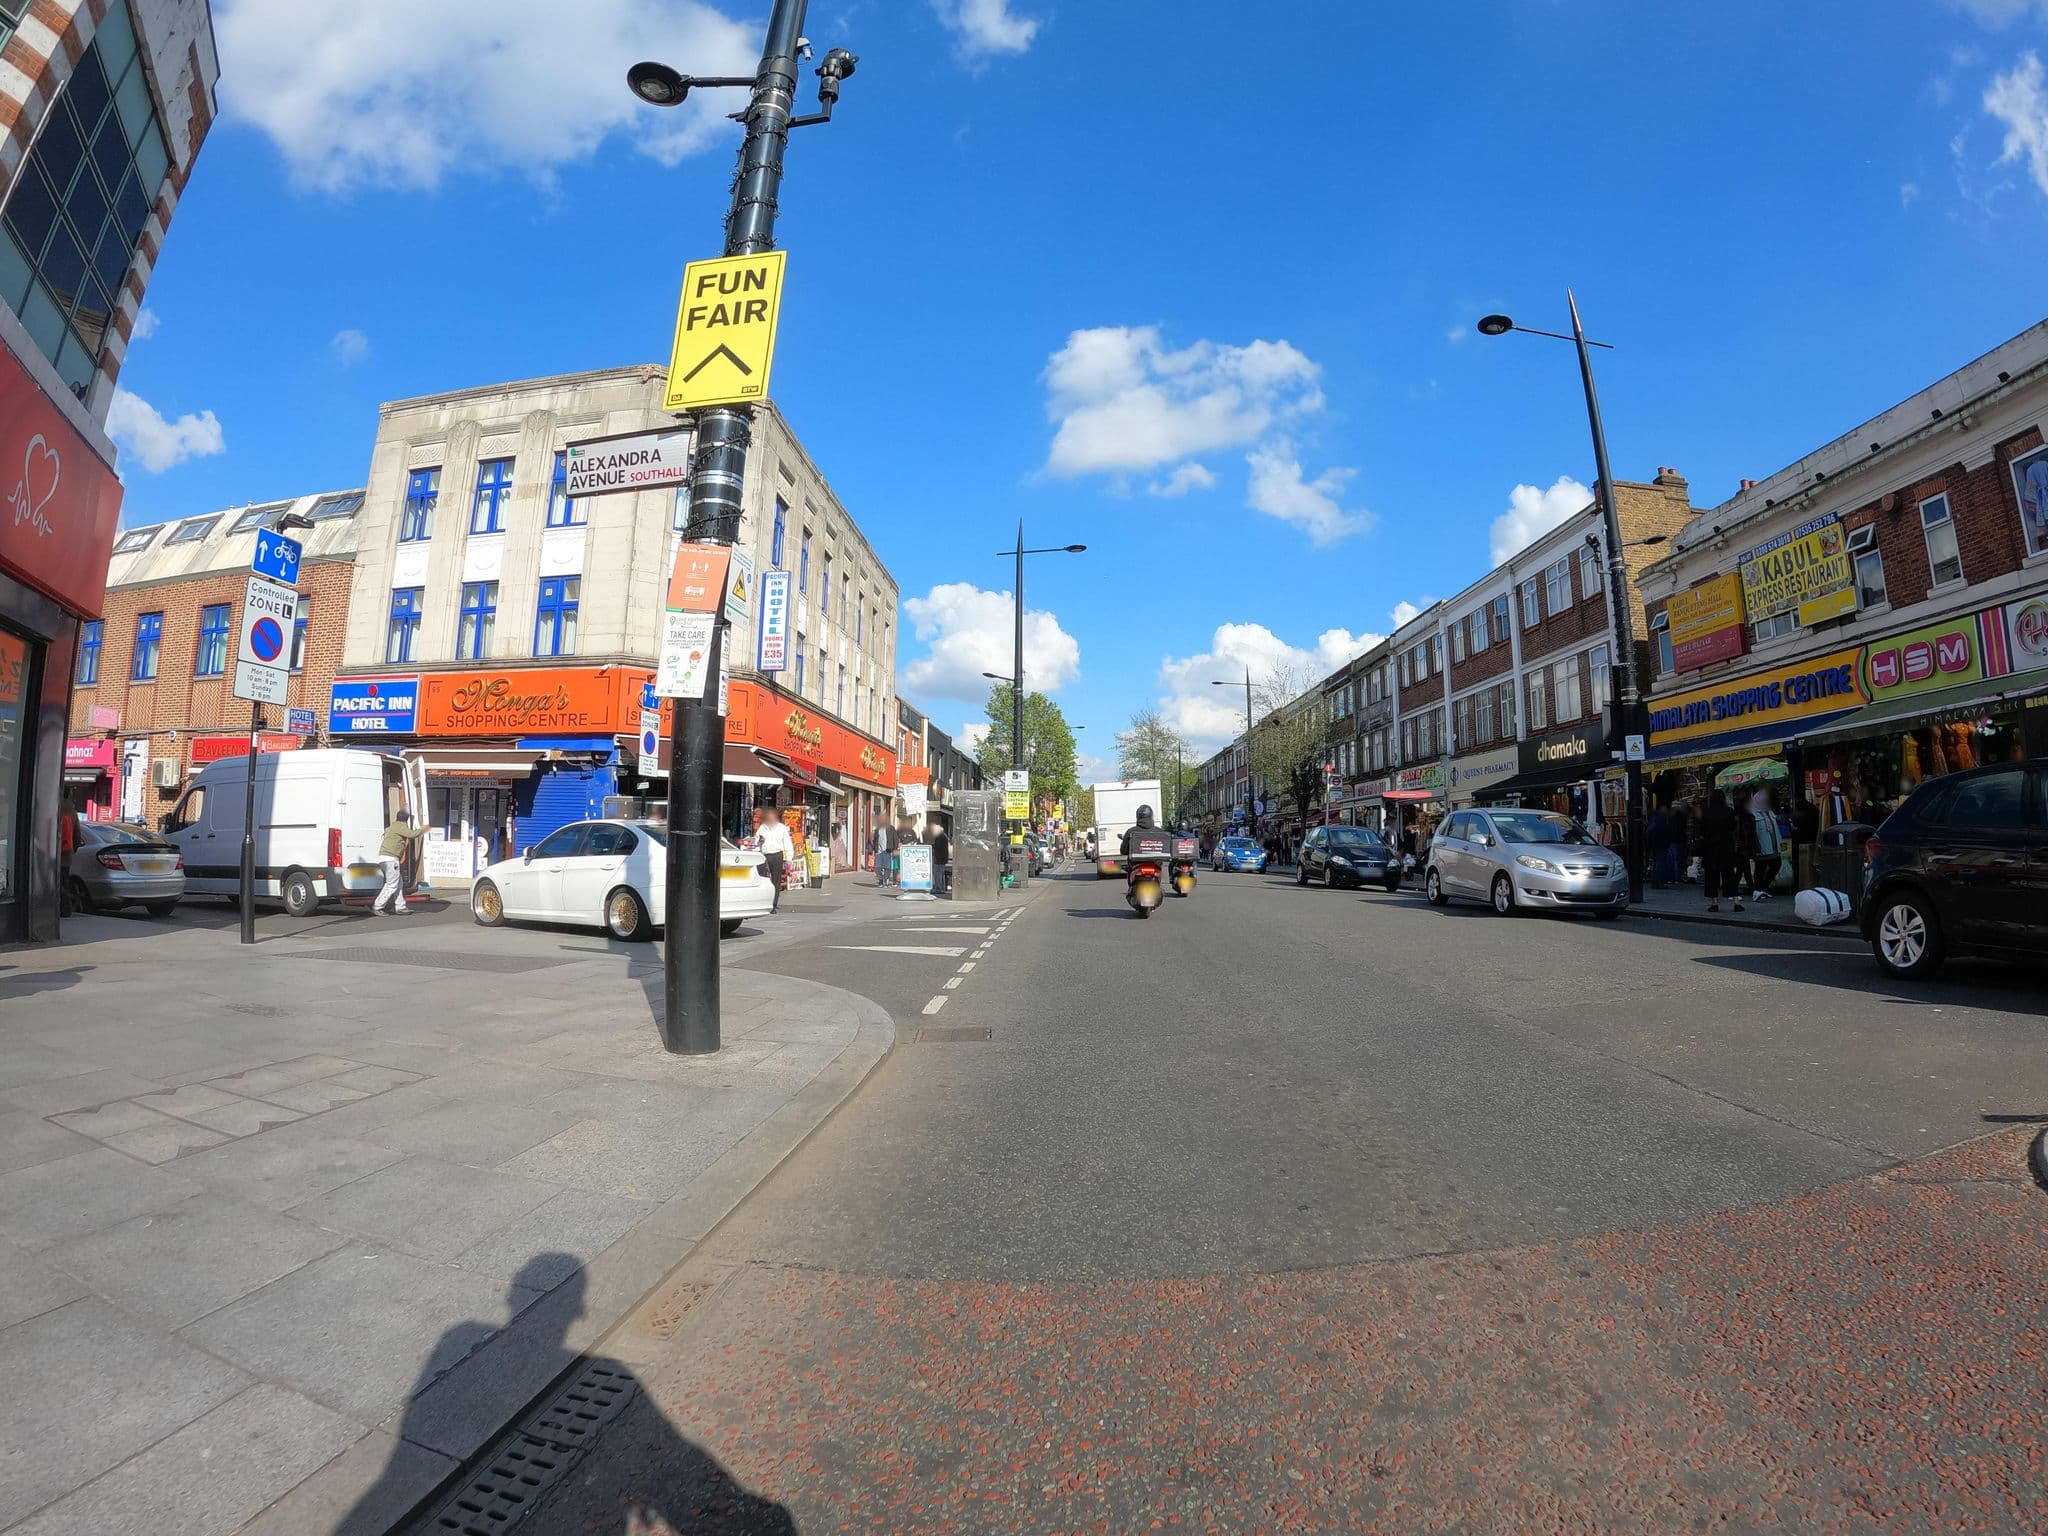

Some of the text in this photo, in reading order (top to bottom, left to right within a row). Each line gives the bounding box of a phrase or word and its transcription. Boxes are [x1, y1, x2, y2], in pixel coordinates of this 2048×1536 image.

[696, 267, 768, 298] FUN
[686, 298, 768, 331] FAIR
[569, 448, 662, 475] ALEXANDRA
[569, 466, 685, 491] AVENUE SOUTHALL
[1762, 541, 1819, 584] KABUL
[251, 582, 295, 604] Controlled
[1746, 556, 1846, 611] EXPRESS RESTAURANT
[249, 595, 292, 618] ZONE L
[768, 589, 784, 635] HOTEL
[669, 630, 706, 639] TAKE CARE
[764, 649, 783, 659] £35
[1872, 638, 1966, 681] HSM
[251, 683, 272, 694] Sunday
[1650, 664, 1853, 733] HIMALAYA SHOPPING CENTRE
[333, 696, 413, 712] PACIFIC INN
[451, 678, 570, 724] Monga's
[291, 709, 313, 721] HOTEL
[351, 717, 389, 730] HOTEL
[446, 713, 588, 728] SHOPPING CENTRE
[1920, 707, 1987, 726] HIMALAYA
[1537, 735, 1587, 762] dhamaka
[1484, 761, 1514, 775] PHARMACY
